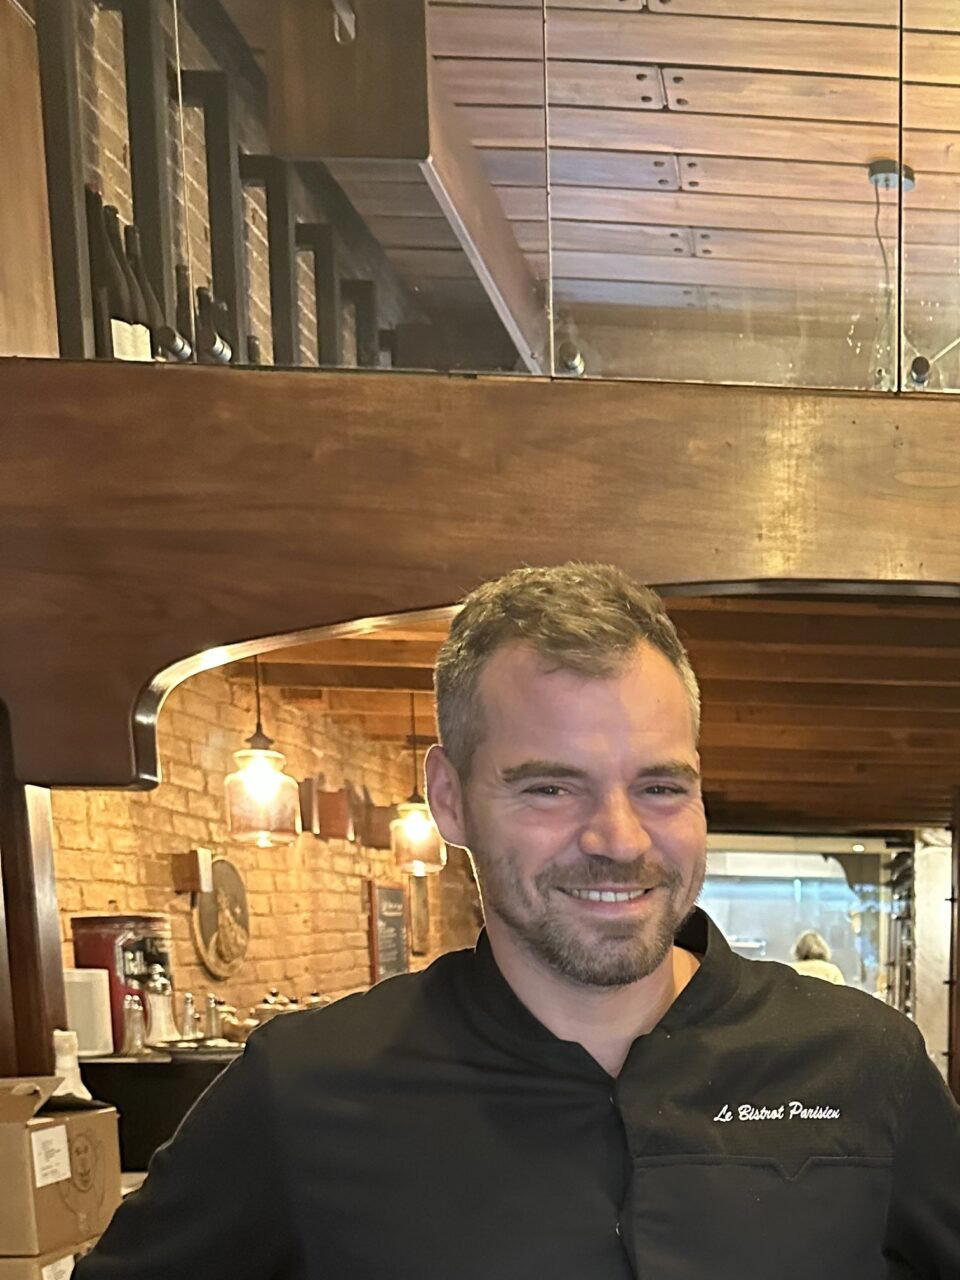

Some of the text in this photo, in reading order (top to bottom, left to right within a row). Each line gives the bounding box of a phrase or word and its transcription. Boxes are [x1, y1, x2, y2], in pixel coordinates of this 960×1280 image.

[713, 1101, 841, 1122] Le Bistrot Parisien
